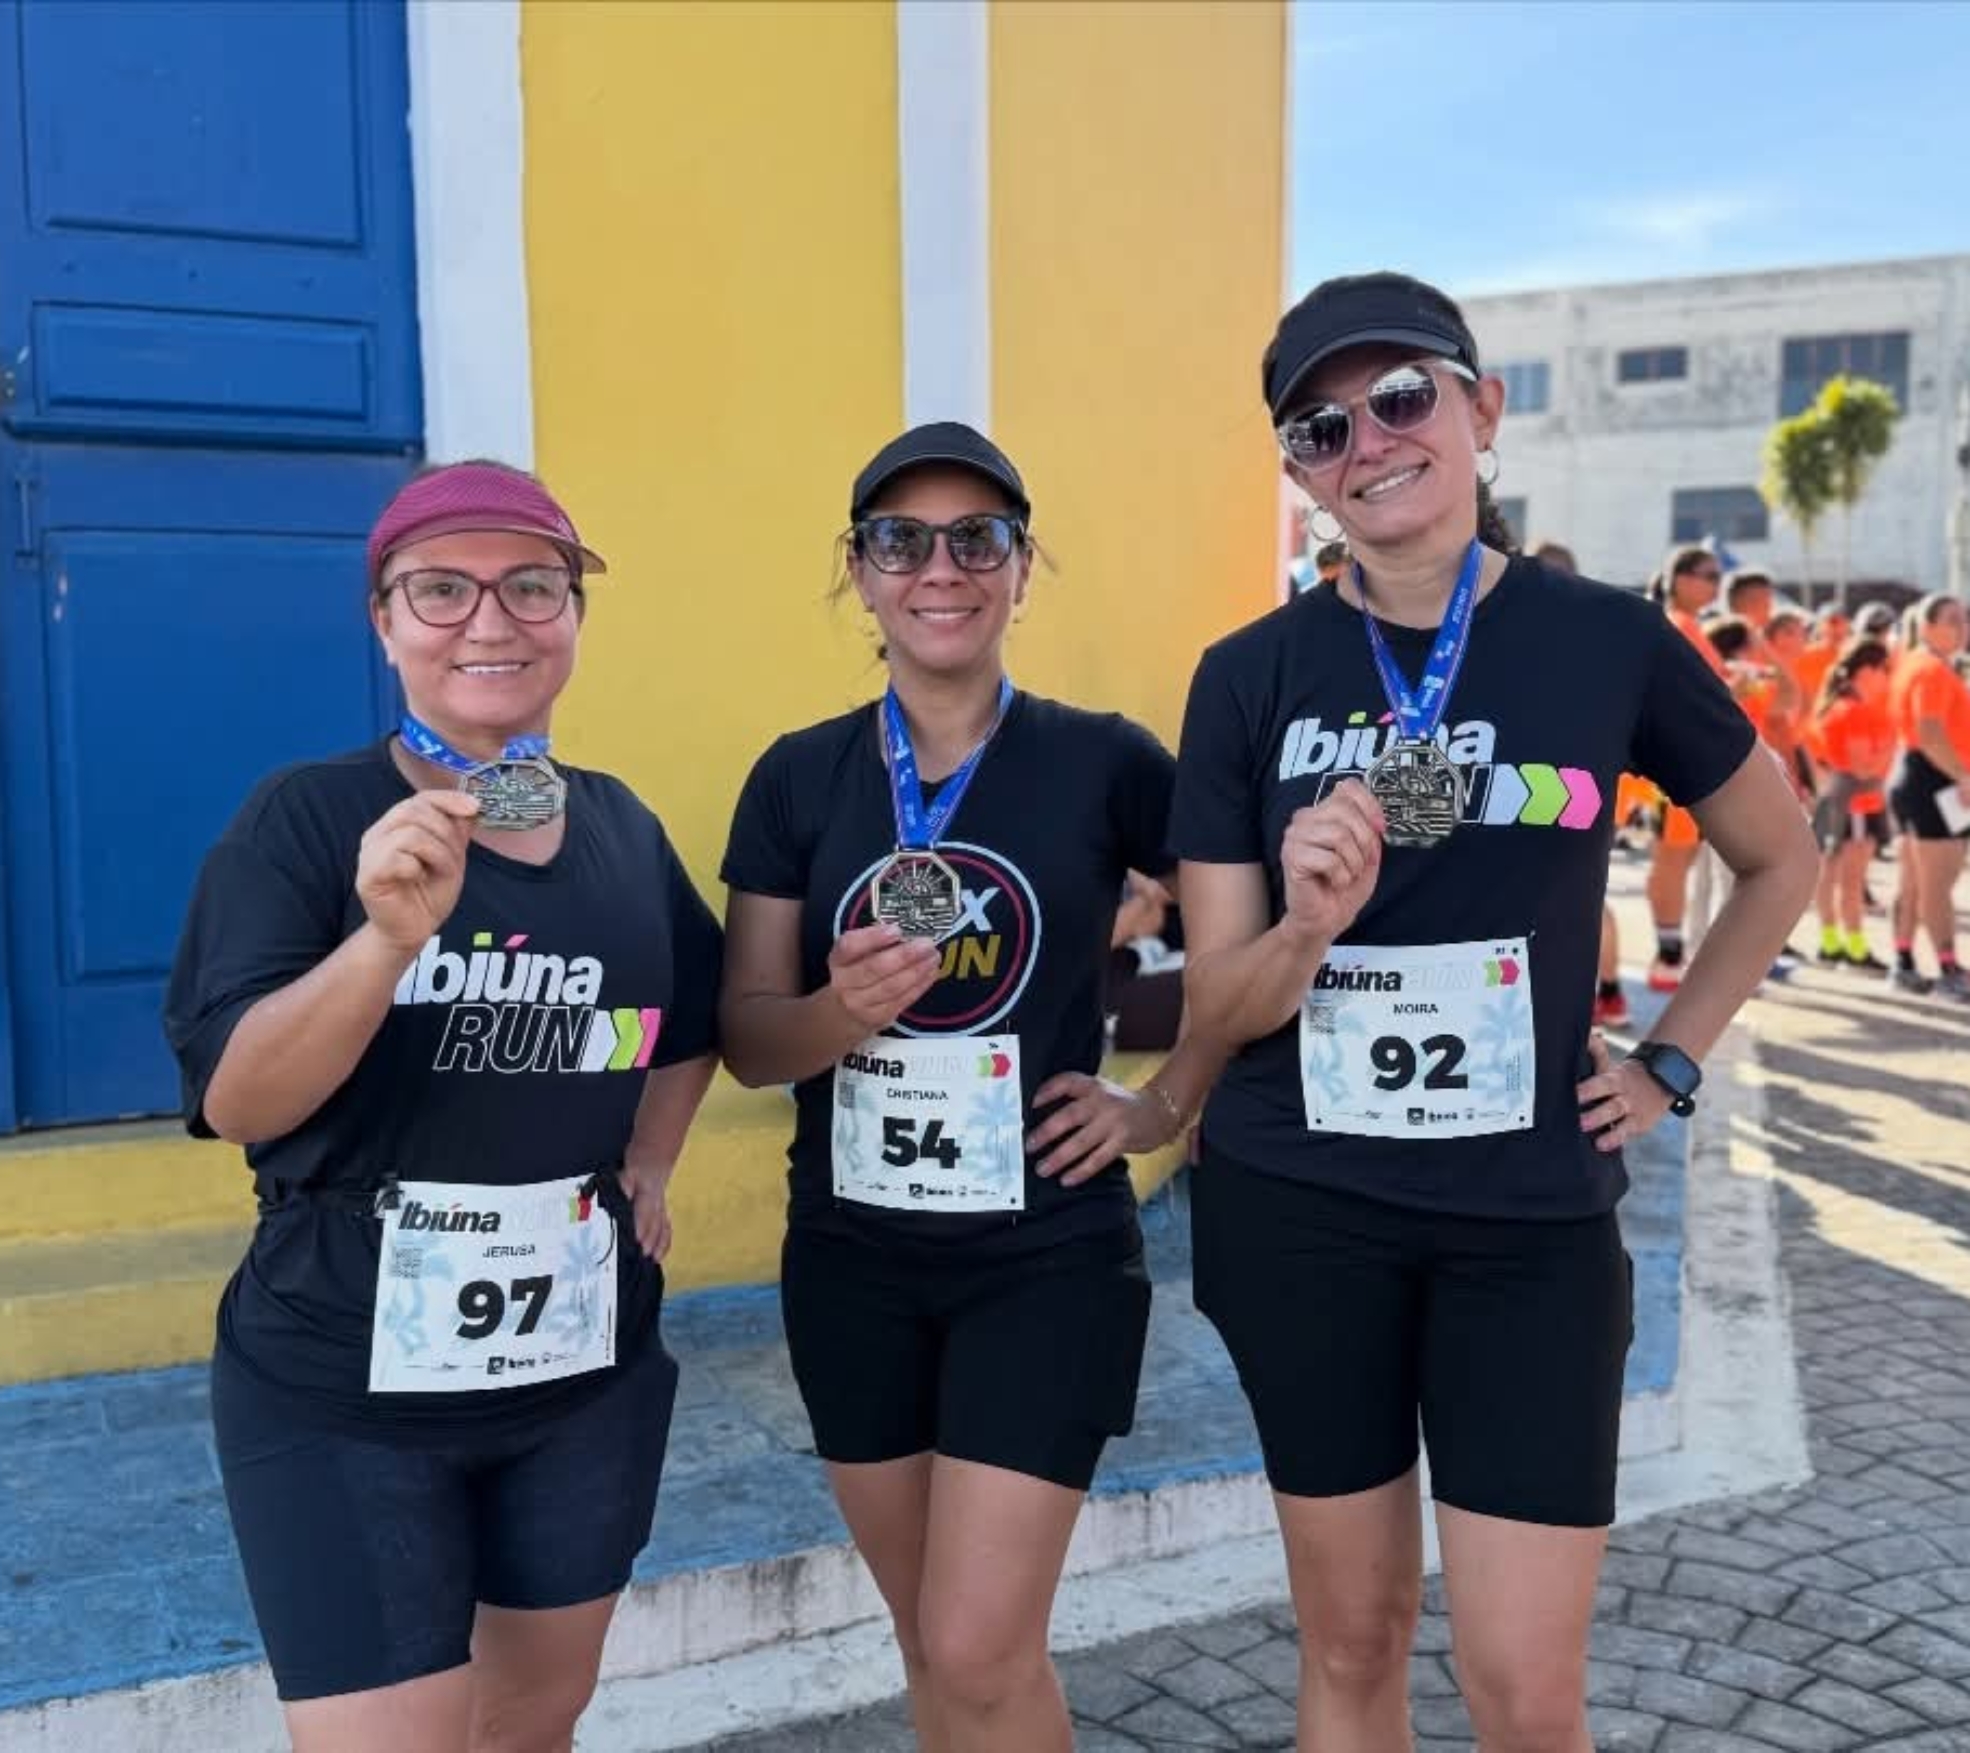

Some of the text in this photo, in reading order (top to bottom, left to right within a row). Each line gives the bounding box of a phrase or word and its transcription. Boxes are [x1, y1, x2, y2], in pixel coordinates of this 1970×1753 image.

[432, 1003, 597, 1073] RUN
[1370, 1034, 1468, 1091] 92
[886, 1087, 949, 1101] CRISTIANA
[881, 1116, 962, 1170] 54
[398, 1201, 501, 1233] Ibiúna
[482, 1245, 536, 1259] JERUSA
[456, 1274, 554, 1341] 97
